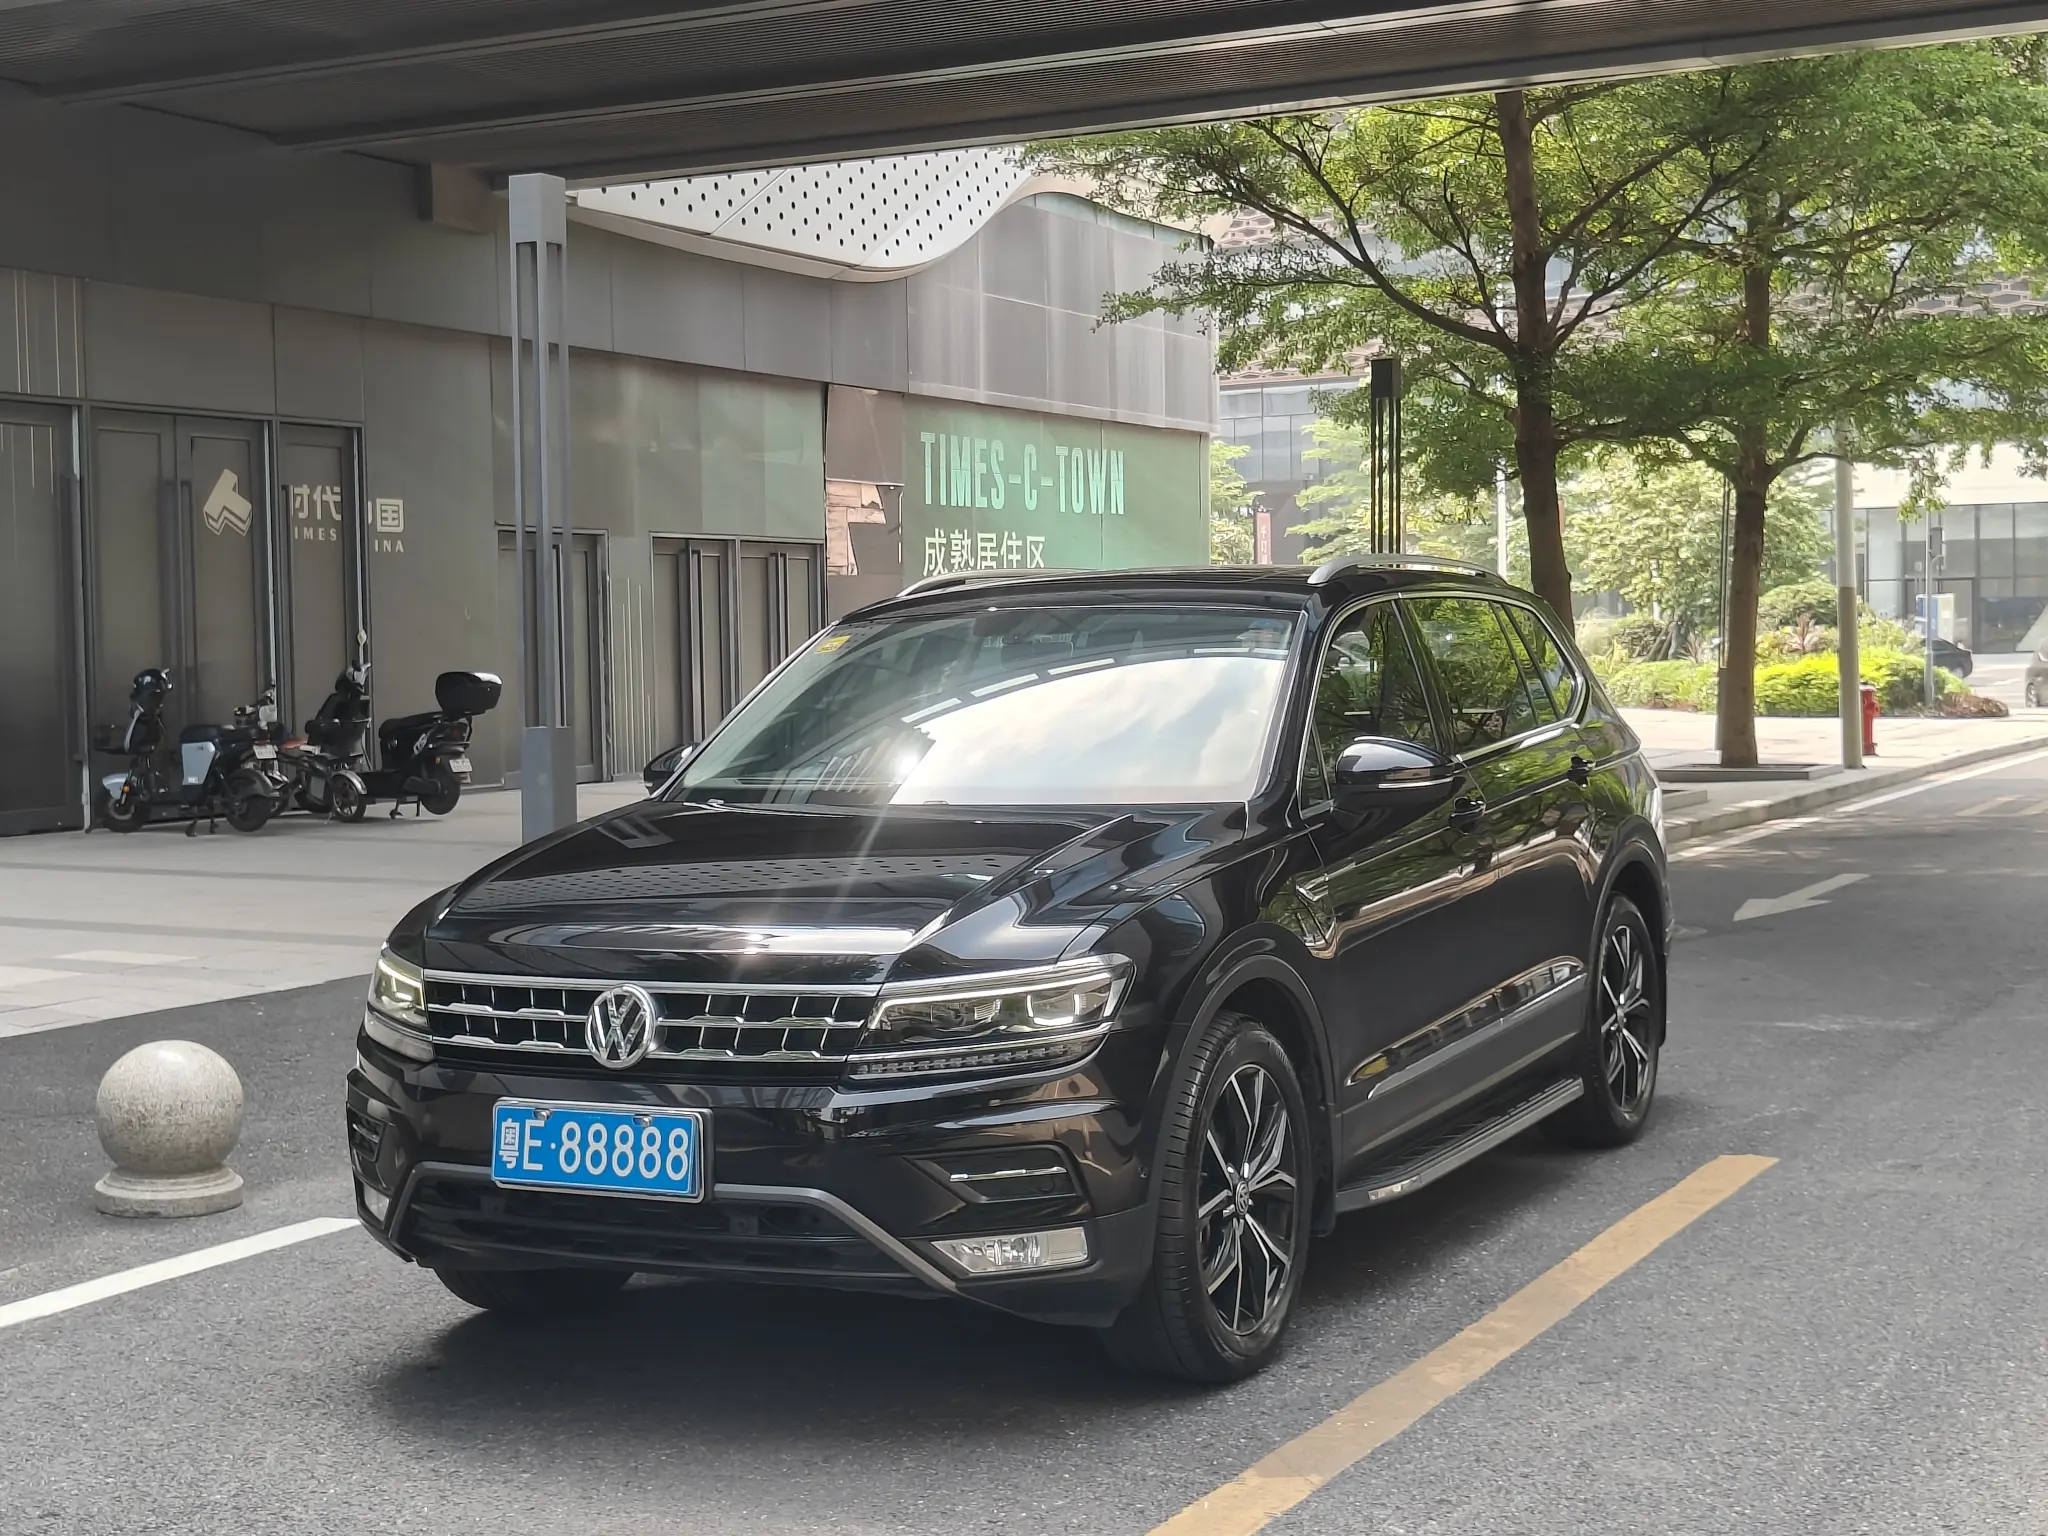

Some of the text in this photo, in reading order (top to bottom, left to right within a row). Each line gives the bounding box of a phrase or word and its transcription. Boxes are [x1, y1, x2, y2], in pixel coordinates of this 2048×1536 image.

[920, 432, 1124, 515] TIMES-C-TOWN
[294, 526, 337, 542] IMES
[922, 527, 1046, 577] 成熟居住区
